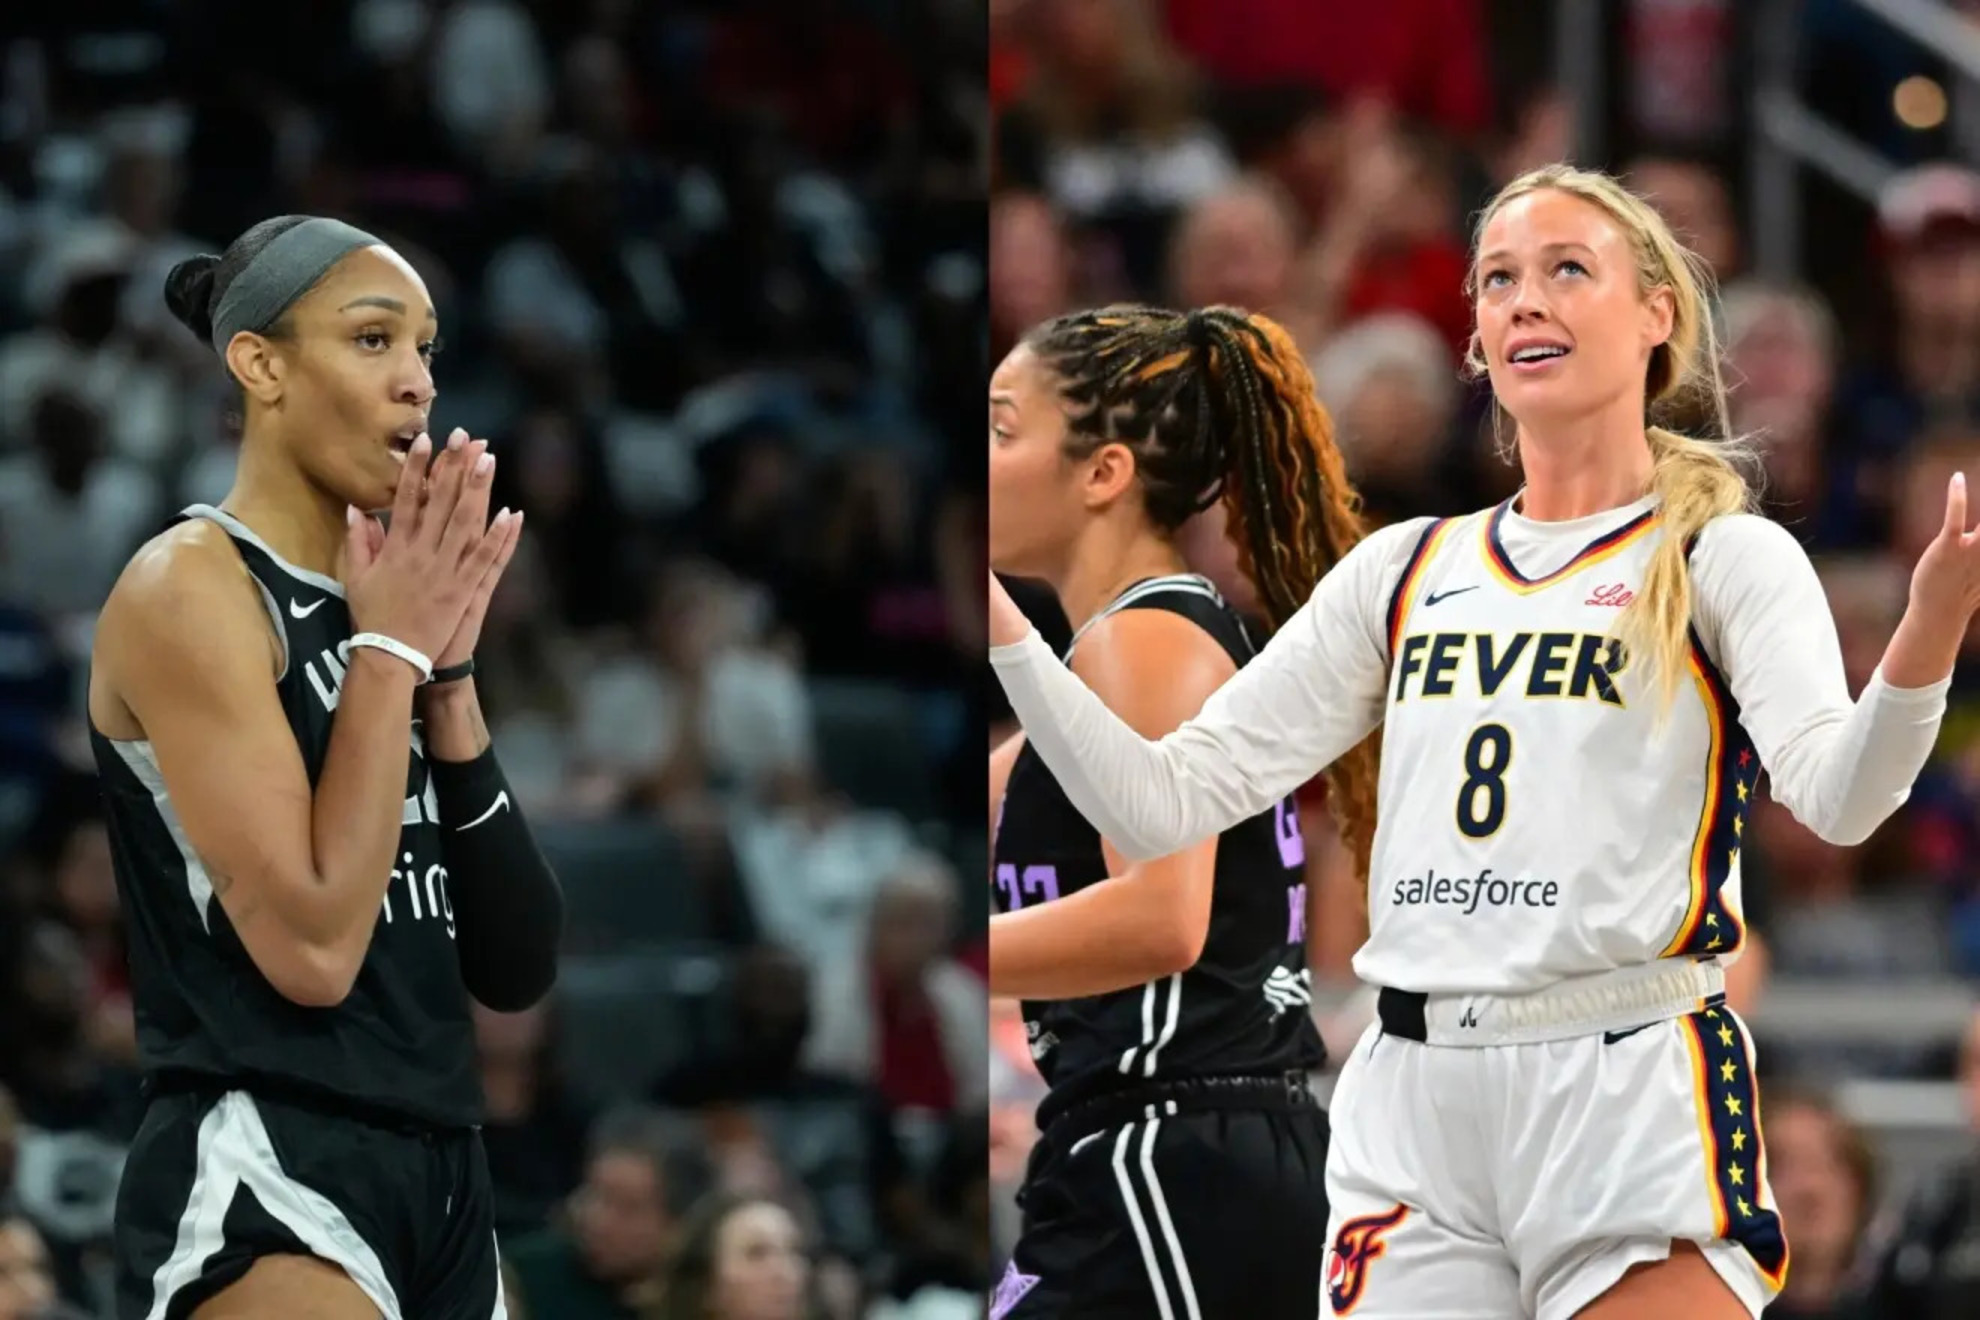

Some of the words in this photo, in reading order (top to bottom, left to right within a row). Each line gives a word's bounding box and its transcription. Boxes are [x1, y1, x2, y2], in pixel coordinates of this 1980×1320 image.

[1394, 632, 1628, 707] FEVER
[1455, 722, 1513, 840] 8
[1392, 869, 1559, 915] salesforce
